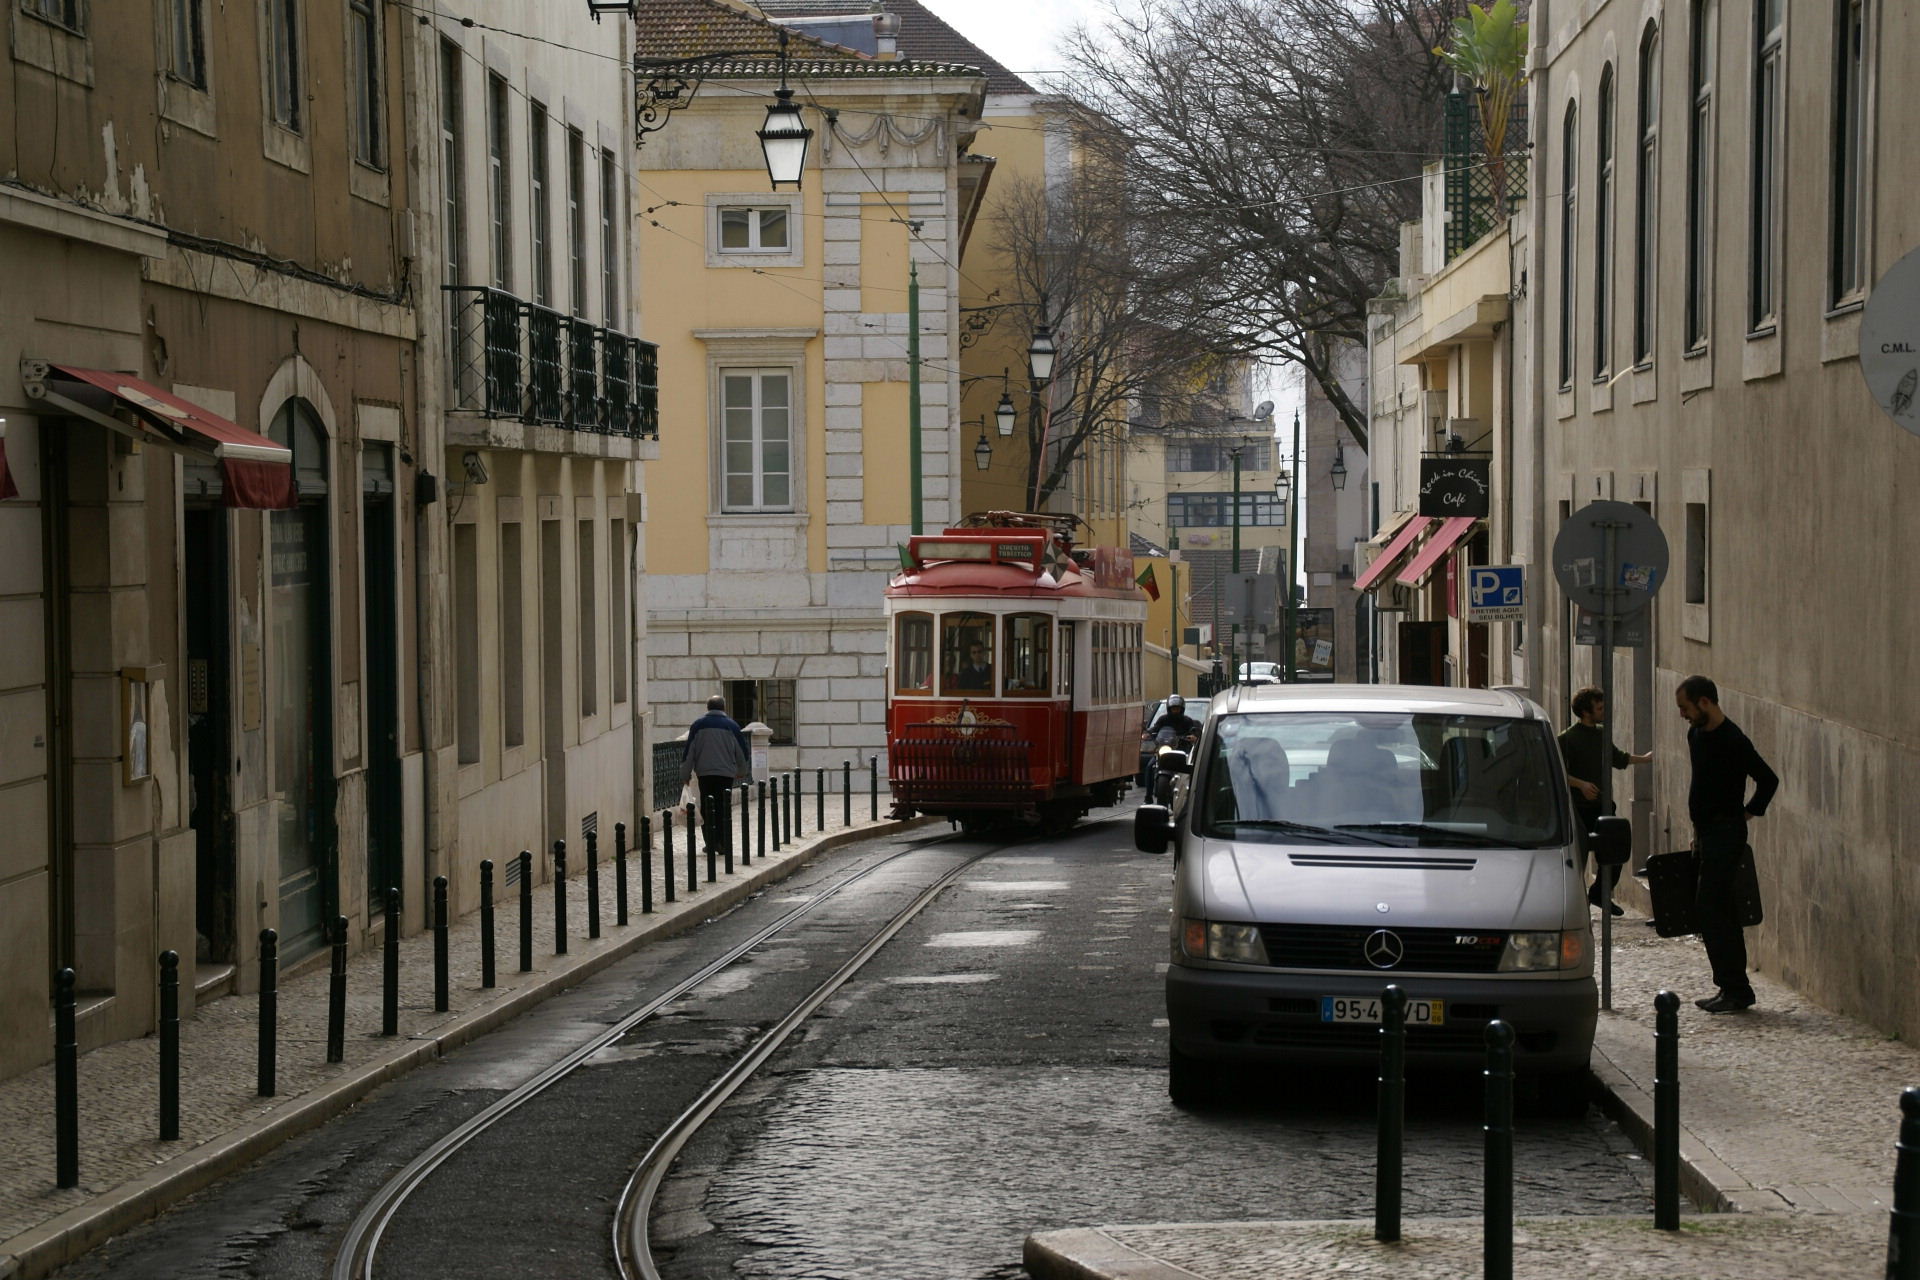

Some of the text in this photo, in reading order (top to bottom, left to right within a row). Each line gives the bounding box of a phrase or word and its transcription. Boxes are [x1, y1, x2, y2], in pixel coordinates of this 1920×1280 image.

[1880, 342, 1917, 354] C.M.L.
[1420, 471, 1441, 495] Rock
[1442, 468, 1456, 478] in
[1442, 492, 1467, 508] Café
[1476, 571, 1501, 605] P
[1475, 607, 1501, 615] RETIRE
